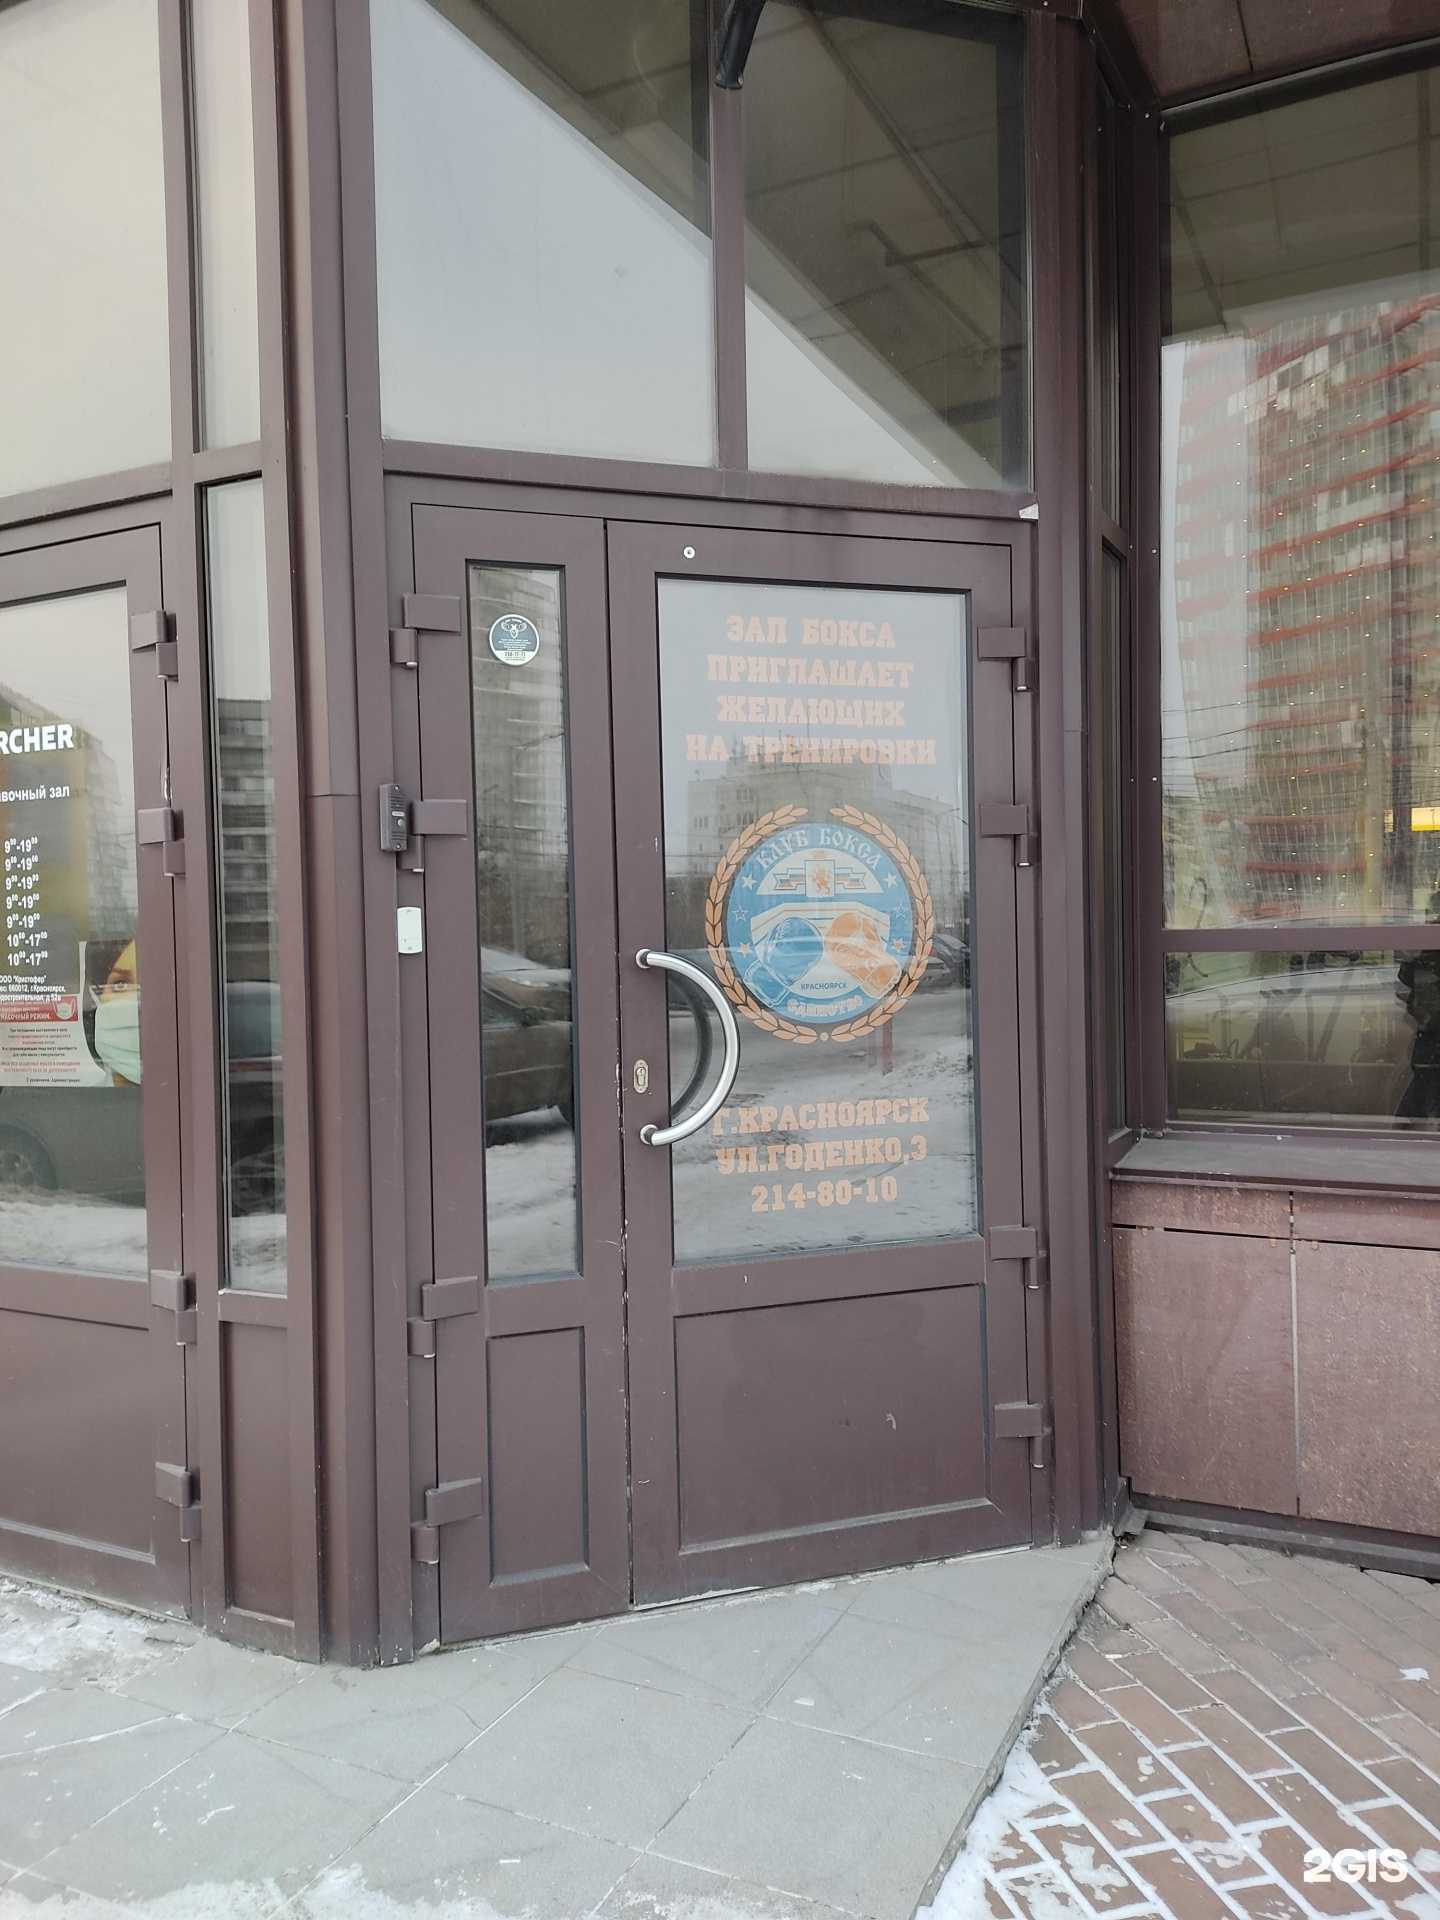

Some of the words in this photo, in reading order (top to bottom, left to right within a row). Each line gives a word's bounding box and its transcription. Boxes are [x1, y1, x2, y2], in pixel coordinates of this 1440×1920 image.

[726, 615, 788, 644] ЗАЛ
[802, 618, 896, 649] БОКСА
[706, 654, 914, 689] ПРИГЛАШАЕТ
[717, 695, 906, 728] ЖЕЛАЮЩИХ
[686, 733, 730, 762] НА
[742, 735, 938, 765] ТРЕНИРОВКИ
[0, 785, 46, 803] вочный
[49, 785, 70, 799] зал
[818, 827, 883, 872] БОКСА
[800, 982, 848, 991] КРАСНОЯРСК
[751, 1175, 898, 1214] 214-80-10
